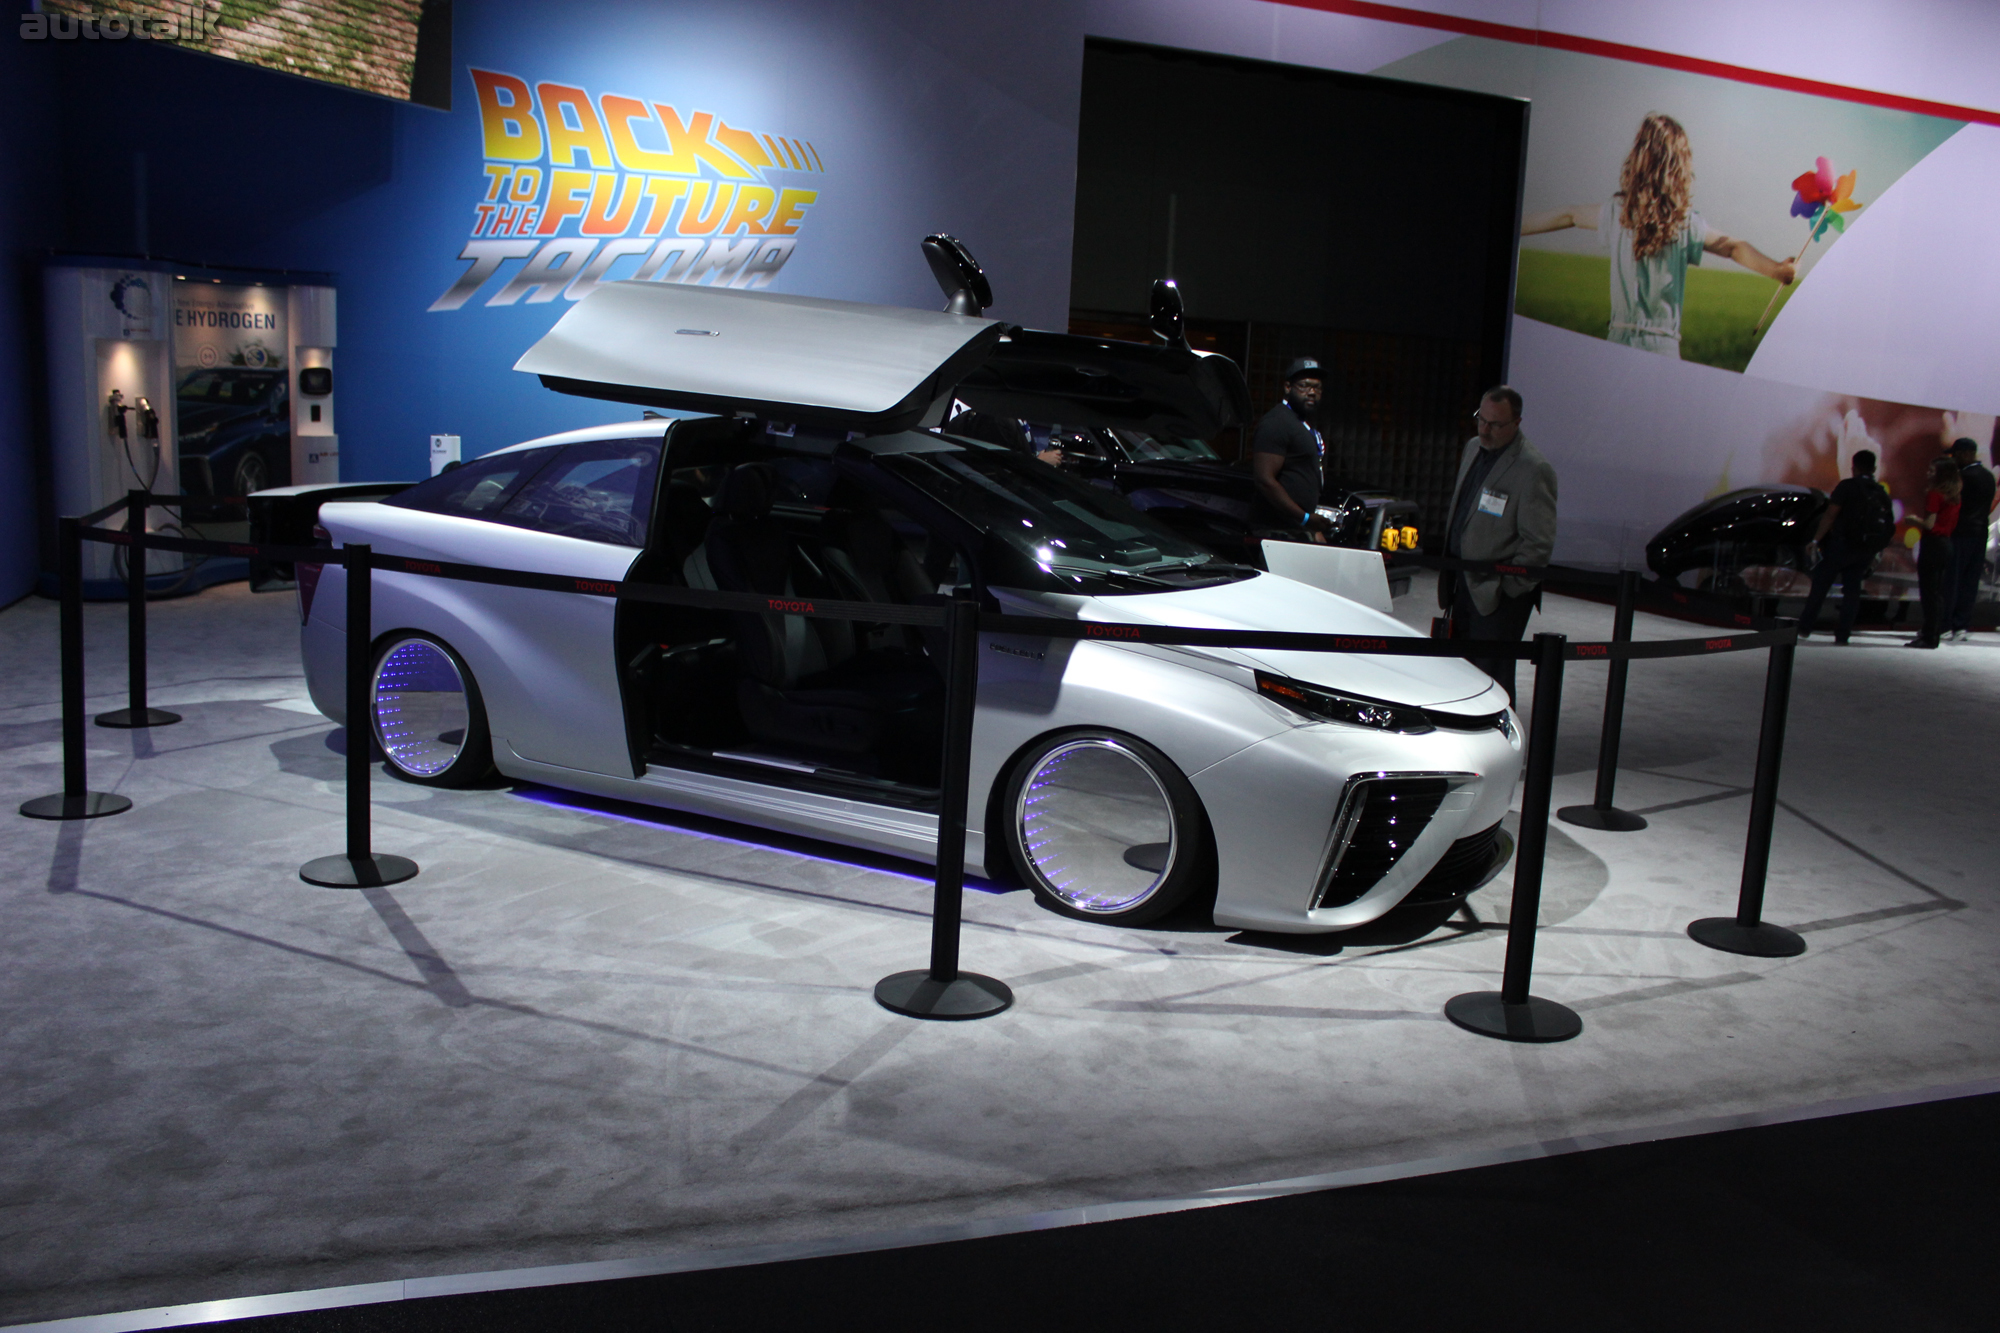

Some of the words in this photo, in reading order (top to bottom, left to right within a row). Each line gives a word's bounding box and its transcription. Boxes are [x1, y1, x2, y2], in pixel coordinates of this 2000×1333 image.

[467, 65, 790, 181] BACK
[483, 163, 543, 204] TO
[534, 167, 821, 238] FUTURE
[471, 203, 540, 238] THE
[426, 238, 799, 313] TACOMA
[187, 310, 276, 330] HYDROGEN
[404, 560, 442, 574] TOYOTA
[575, 580, 617, 594] TOYOTA
[767, 599, 815, 613] TOYOTA
[1494, 563, 1528, 575] TOYOTA
[1085, 625, 1141, 639] TOYOTA
[1333, 637, 1389, 650] TOYOTA
[1576, 645, 1608, 656] TOYOTA
[1705, 639, 1732, 650] TOYOTA
